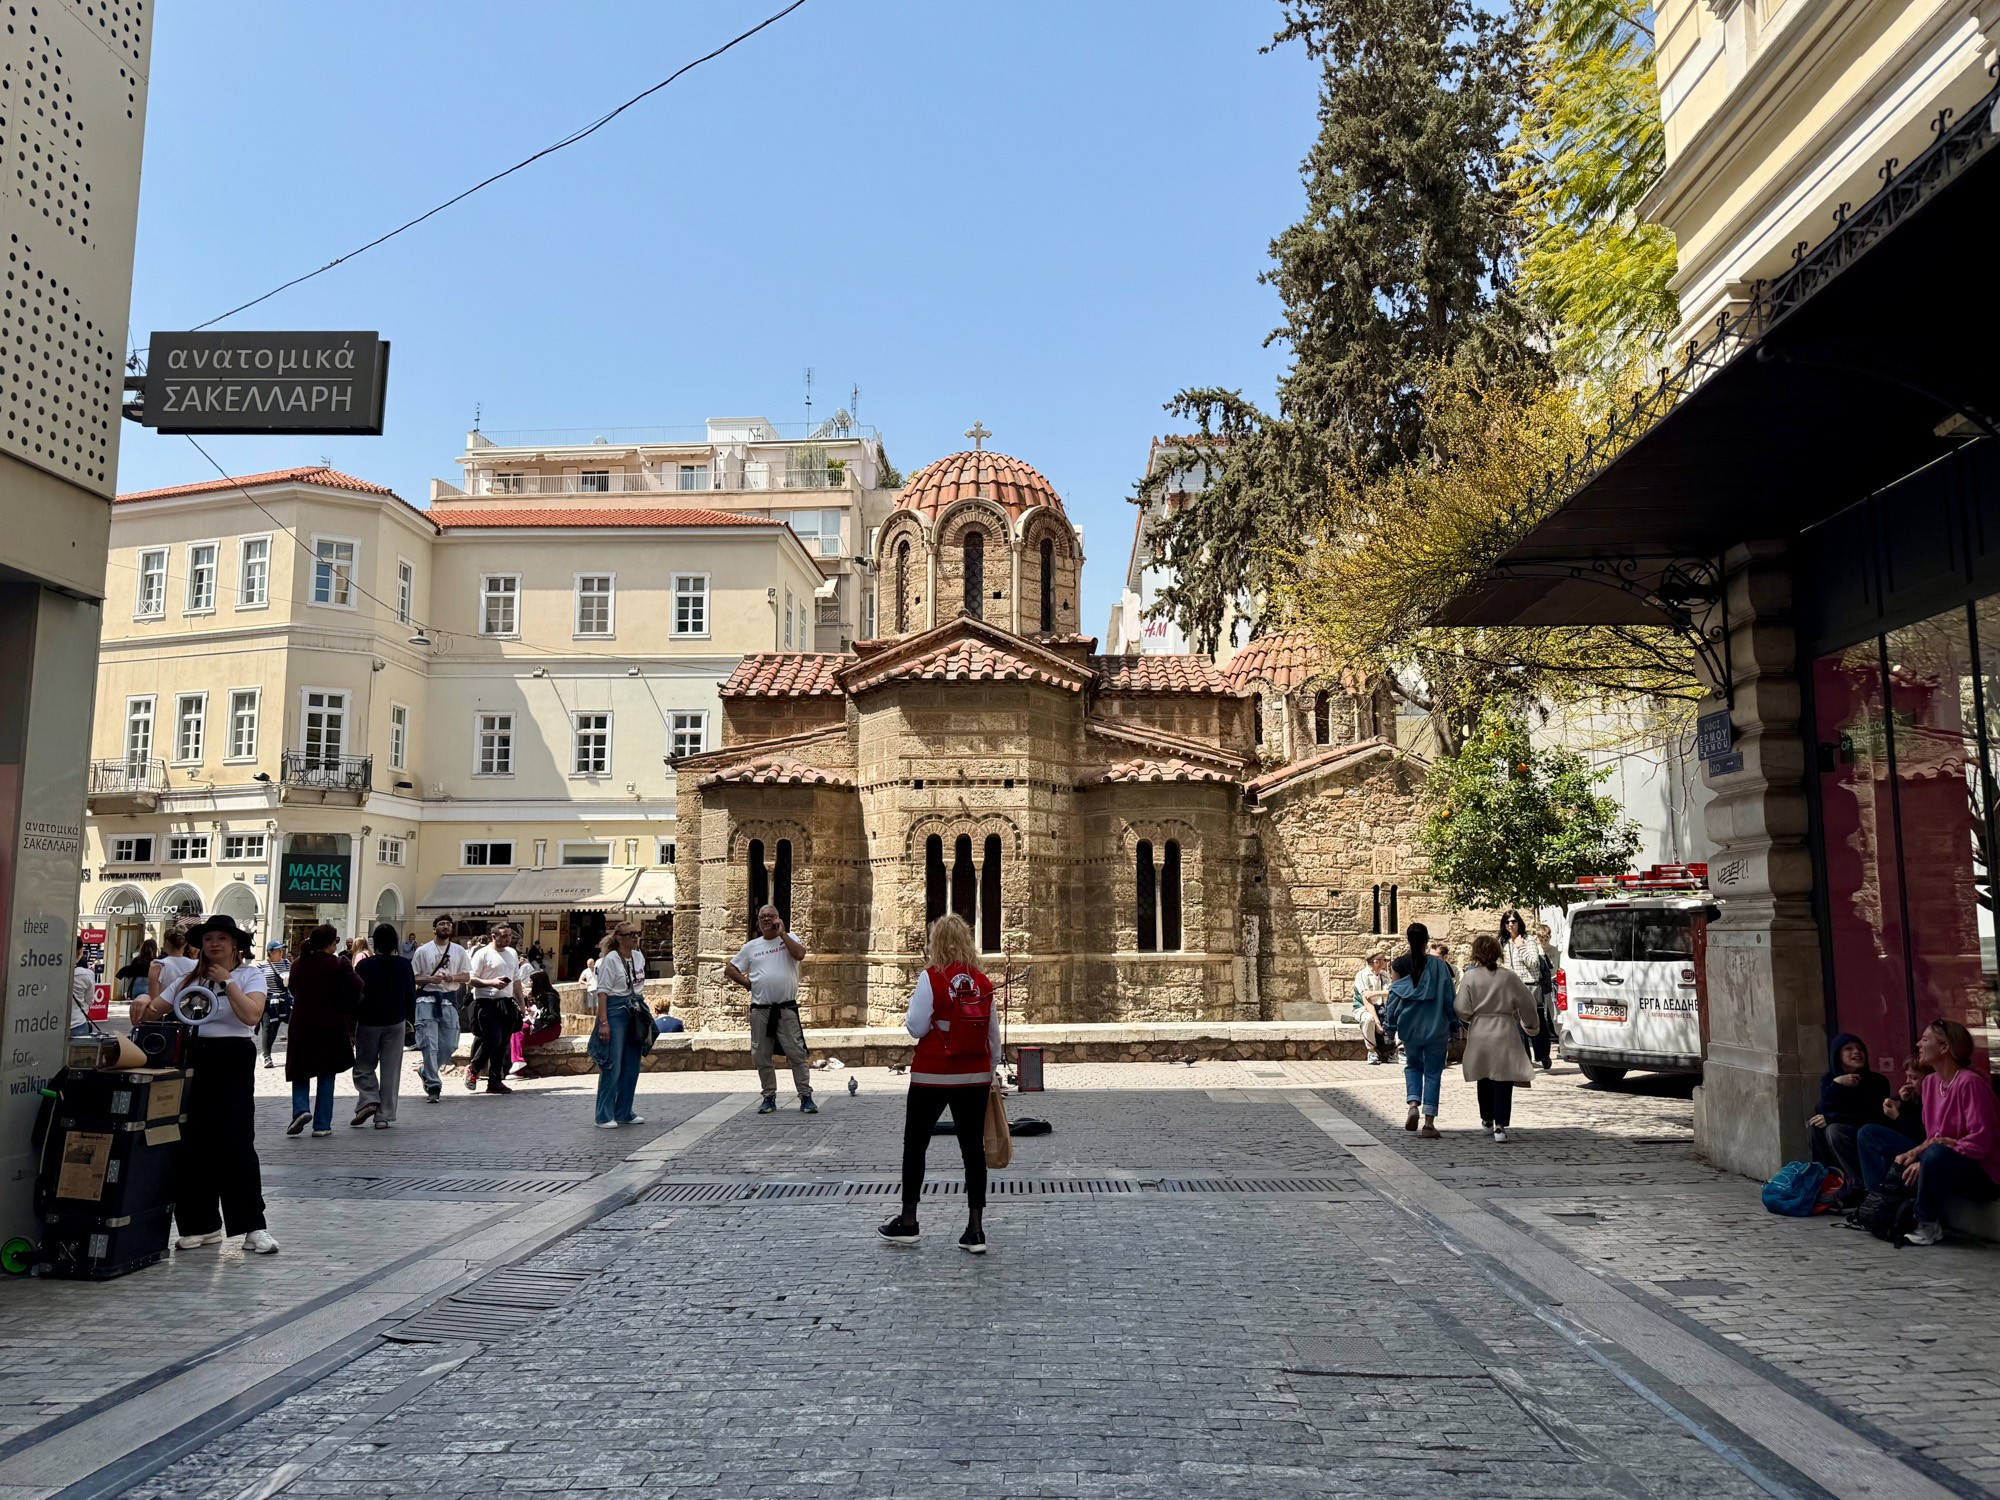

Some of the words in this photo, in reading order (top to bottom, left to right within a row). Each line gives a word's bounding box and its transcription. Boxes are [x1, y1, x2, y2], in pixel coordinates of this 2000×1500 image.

[167, 340, 355, 376] ανατομικά
[162, 385, 352, 413] ΣΑΚΕΛΛΑΡΗ
[1704, 719, 1720, 732] ΟΔΟΣ
[1699, 728, 1728, 745] ΕΡΜΟΥ
[1841, 740, 1852, 750] OF
[1853, 732, 1887, 749] BENETTO
[1700, 740, 1728, 754] ERMOU
[25, 821, 79, 836] ανατομικά
[23, 837, 78, 853] ΣΑΚΕΛΛΑΡΗ
[288, 863, 342, 877] MARK
[288, 878, 342, 891] AaLEN
[23, 917, 49, 934] these
[20, 948, 63, 967] shoes
[17, 983, 39, 997] are
[1640, 997, 1661, 1010] ΕΡΓΑ
[1663, 998, 1698, 1012] ΔΕΔΔΗΕ
[14, 1010, 59, 1034] made
[12, 1048, 30, 1064] for
[10, 1075, 51, 1095] walkin
